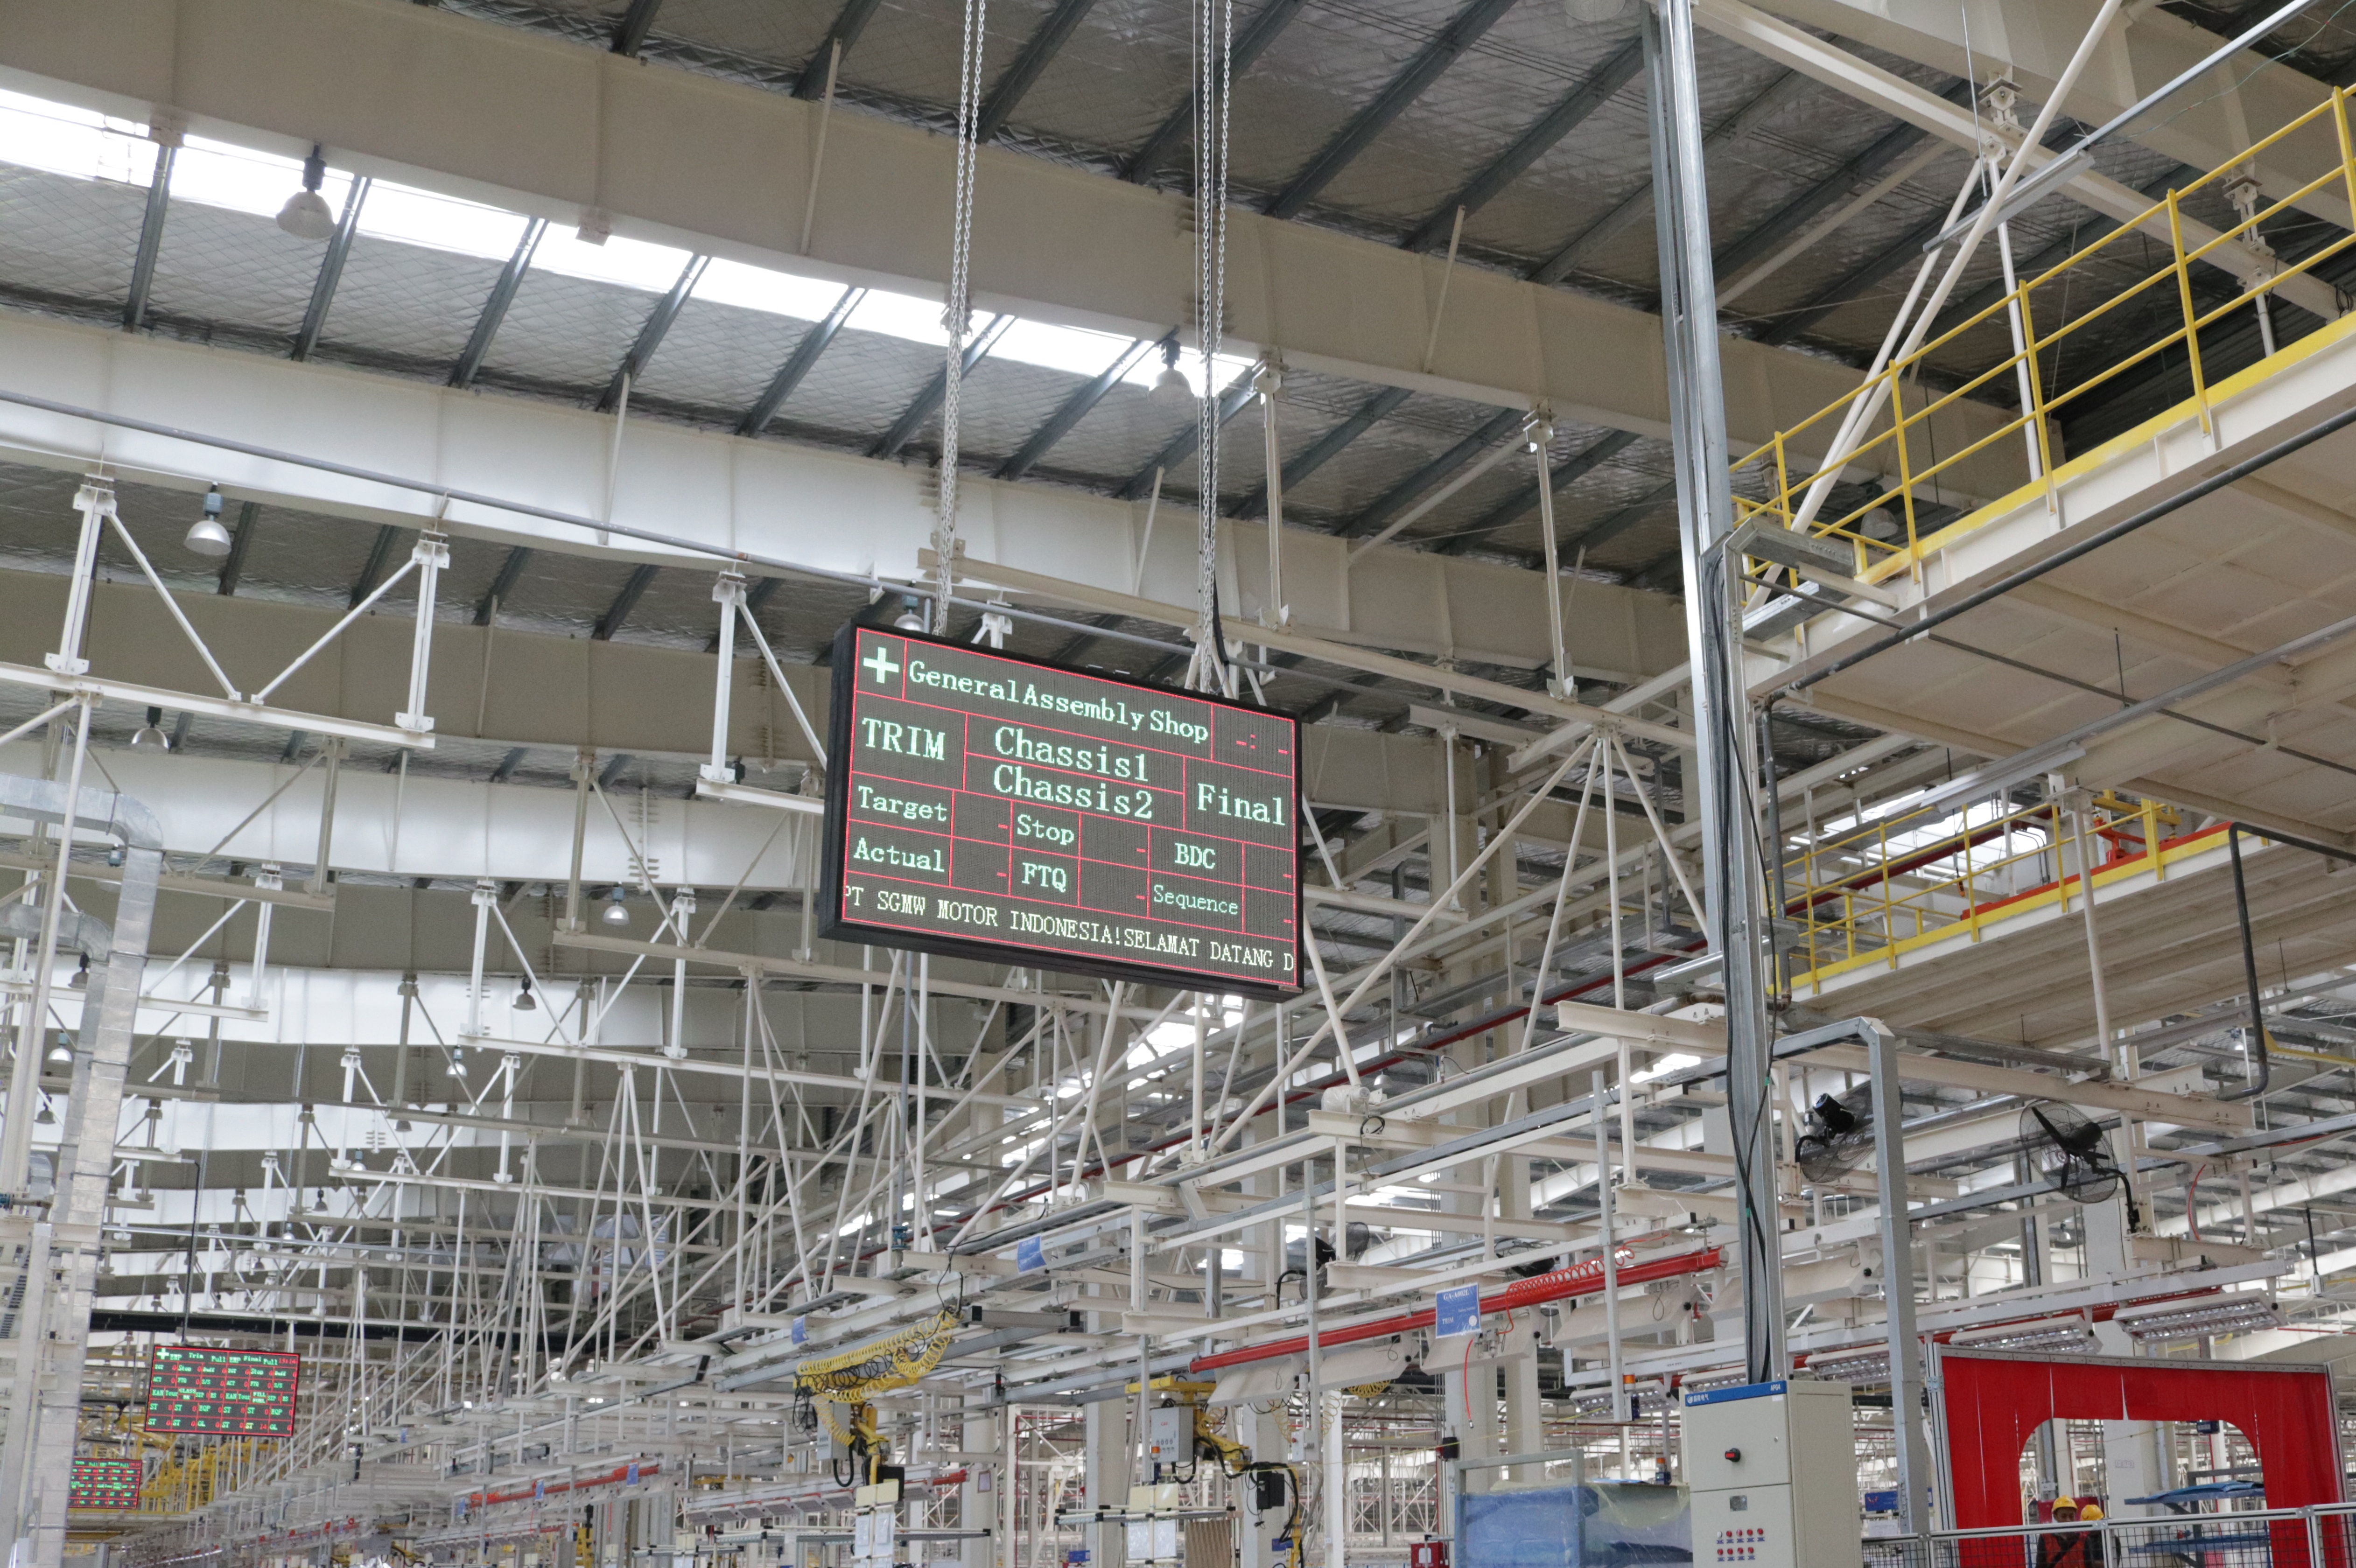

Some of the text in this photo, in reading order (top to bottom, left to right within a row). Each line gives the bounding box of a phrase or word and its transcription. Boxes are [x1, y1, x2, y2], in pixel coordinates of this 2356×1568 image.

[861, 717, 946, 761] TRIM
[1150, 709, 1208, 744] Shop
[994, 726, 1148, 782] Chassis1
[857, 785, 947, 822] Target
[993, 764, 1153, 819] Chassis2
[1197, 782, 1286, 826] Final
[1017, 813, 1075, 846] Stop
[853, 837, 945, 873] Actual
[1174, 842, 1216, 869] BDC
[1021, 861, 1067, 893] FTQ
[1153, 884, 1238, 915] Sequence
[877, 890, 926, 916] SGMW
[937, 899, 998, 927] MOTOR
[1210, 941, 1273, 968] DATANG
[1283, 953, 1294, 971] D
